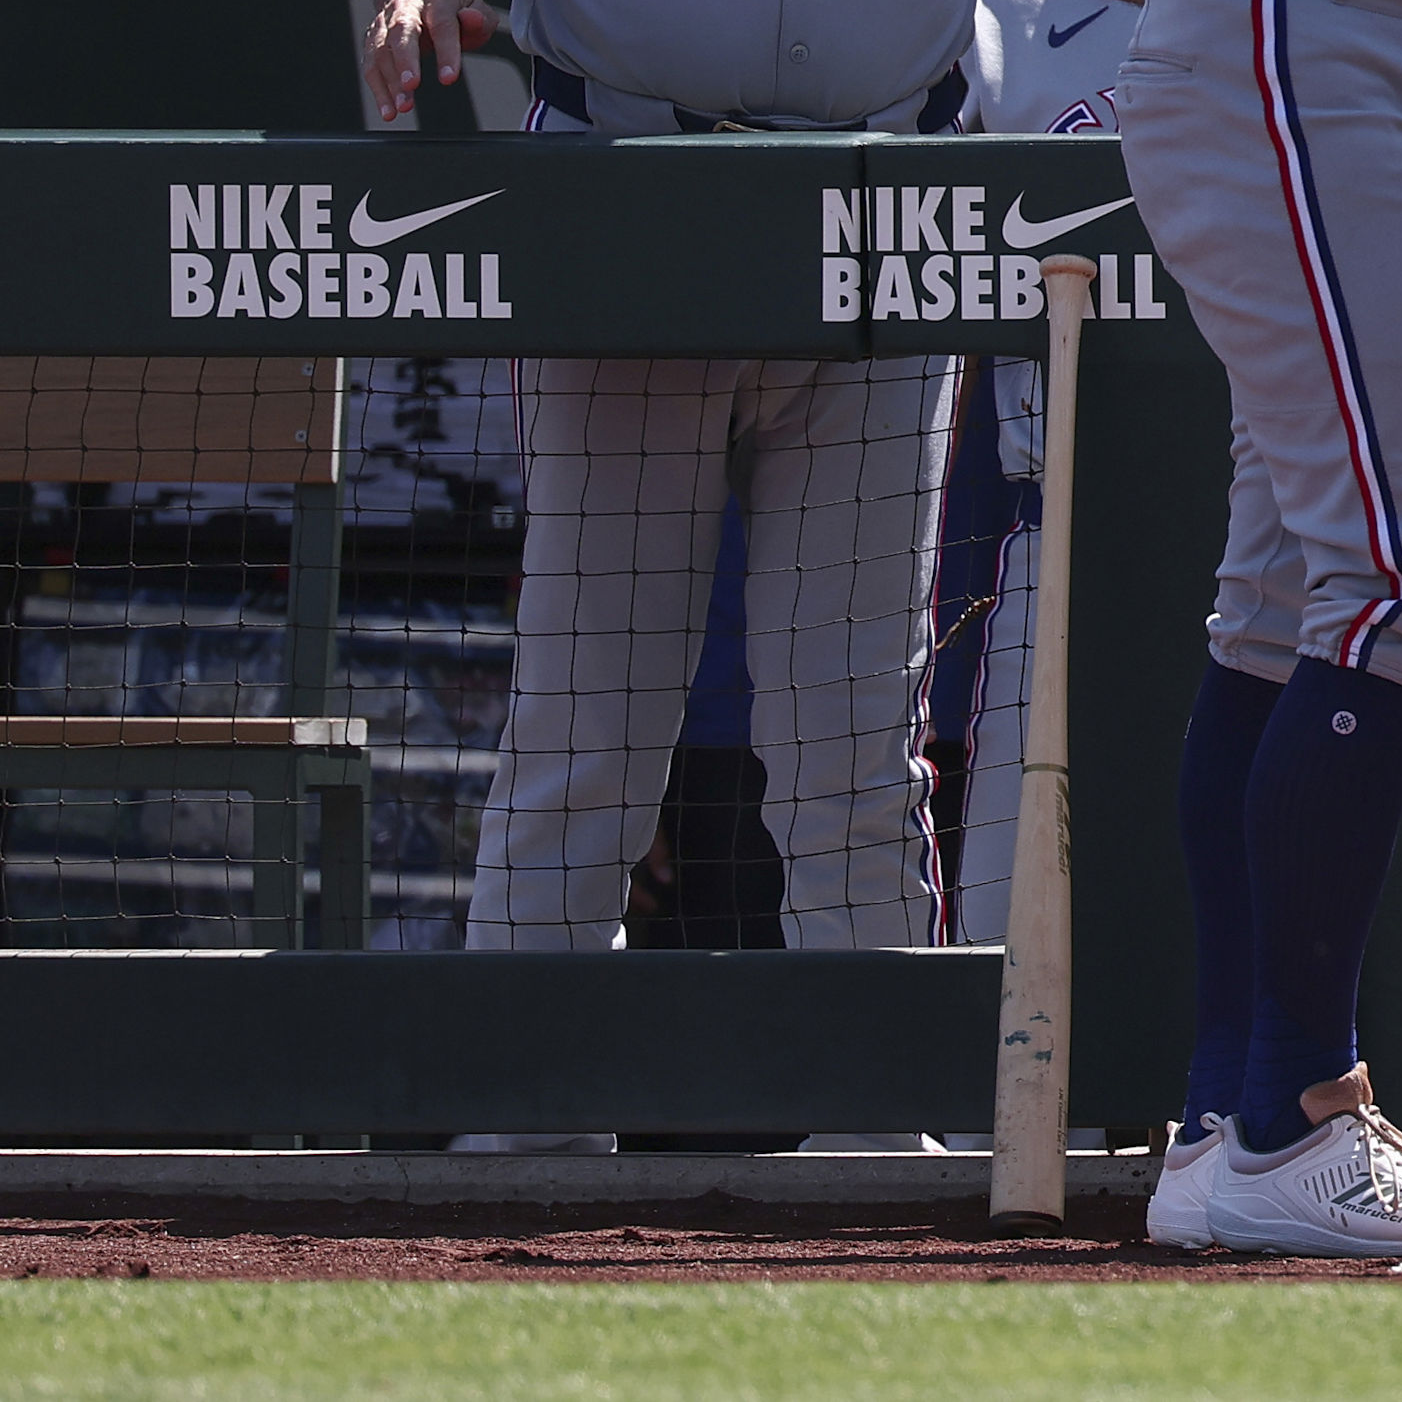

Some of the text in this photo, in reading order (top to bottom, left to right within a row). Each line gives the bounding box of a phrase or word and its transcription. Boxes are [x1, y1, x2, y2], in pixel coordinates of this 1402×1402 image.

[170, 183, 333, 249] NIKE
[822, 186, 986, 253] NIKE
[170, 252, 513, 319] BASEBALL
[822, 253, 1167, 322] BASEBLL
